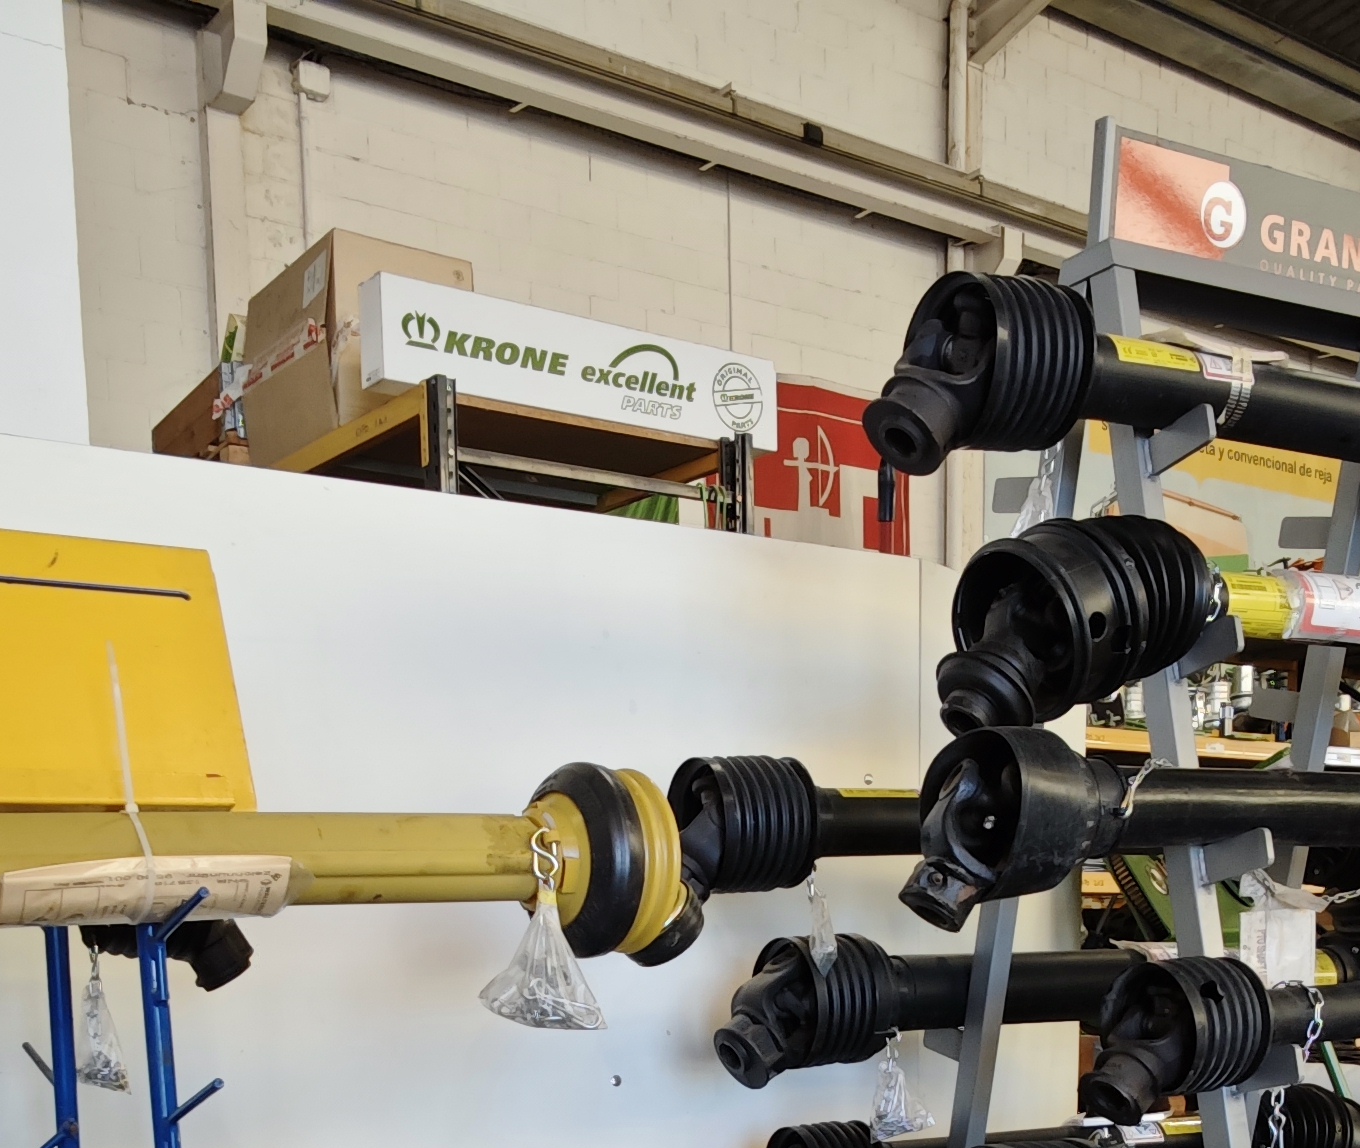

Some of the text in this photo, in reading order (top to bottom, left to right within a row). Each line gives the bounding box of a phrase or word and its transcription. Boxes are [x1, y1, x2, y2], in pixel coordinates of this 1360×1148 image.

[1259, 259, 1338, 288] QUALITY
[443, 330, 697, 403] KRONE excellent
[717, 367, 753, 387] ORIGINAL
[621, 395, 683, 421] PARTS
[1217, 446, 1225, 461] y
[1227, 448, 1297, 475] convencional
[1299, 463, 1313, 478] de
[1314, 467, 1333, 485] reja
